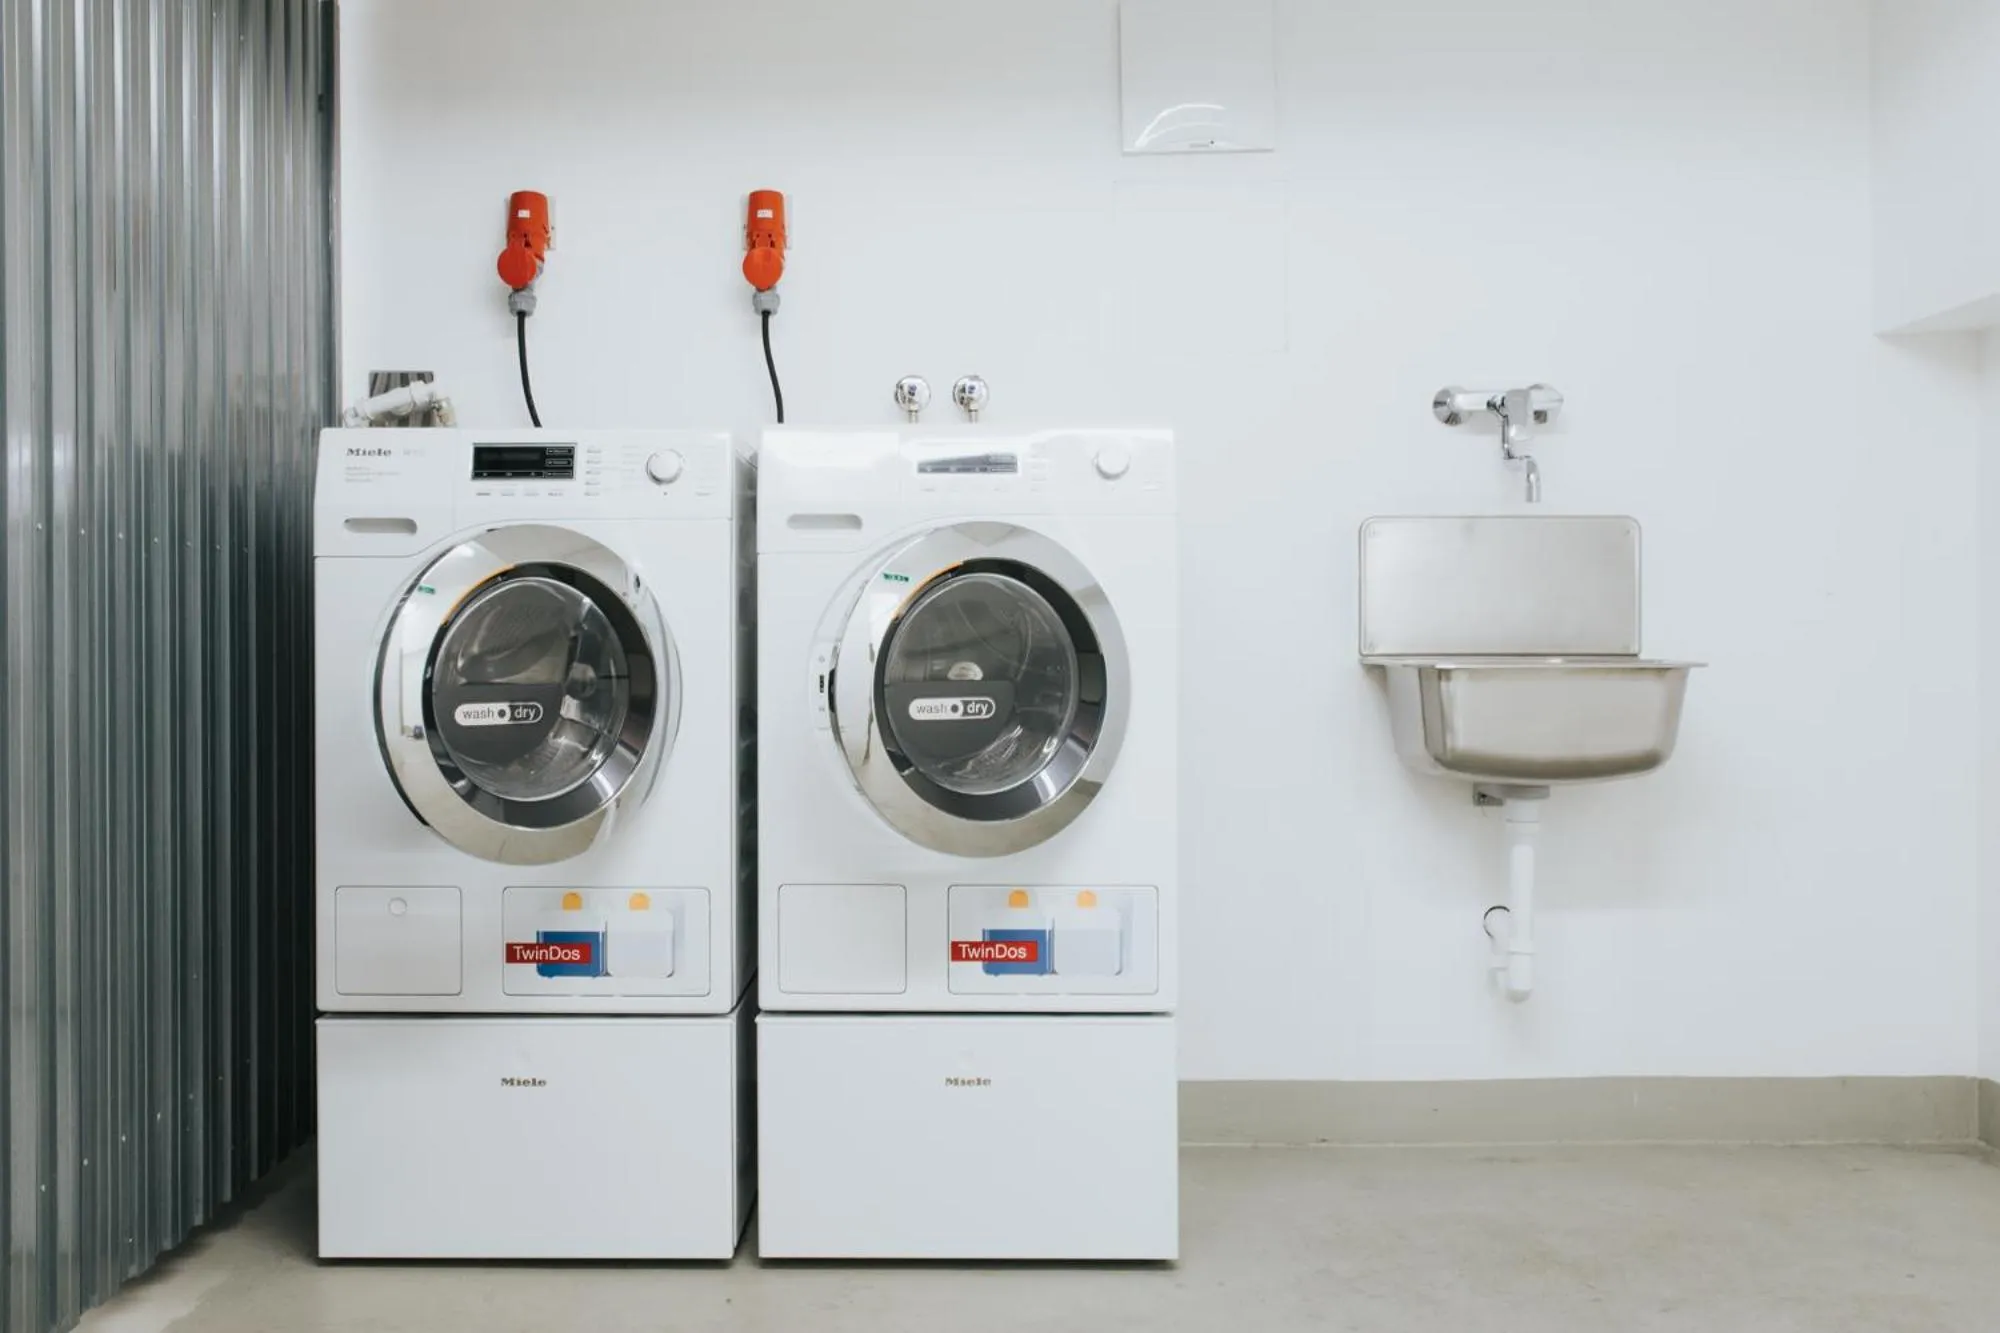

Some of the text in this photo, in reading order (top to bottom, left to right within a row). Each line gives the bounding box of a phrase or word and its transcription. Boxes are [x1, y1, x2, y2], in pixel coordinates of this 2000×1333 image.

[346, 447, 392, 457] Miele
[462, 706, 536, 721] wash dry
[916, 701, 989, 716] wash dry
[512, 945, 581, 961] TwinDos
[958, 943, 1027, 959] TwinDos
[501, 1077, 547, 1087] Miele
